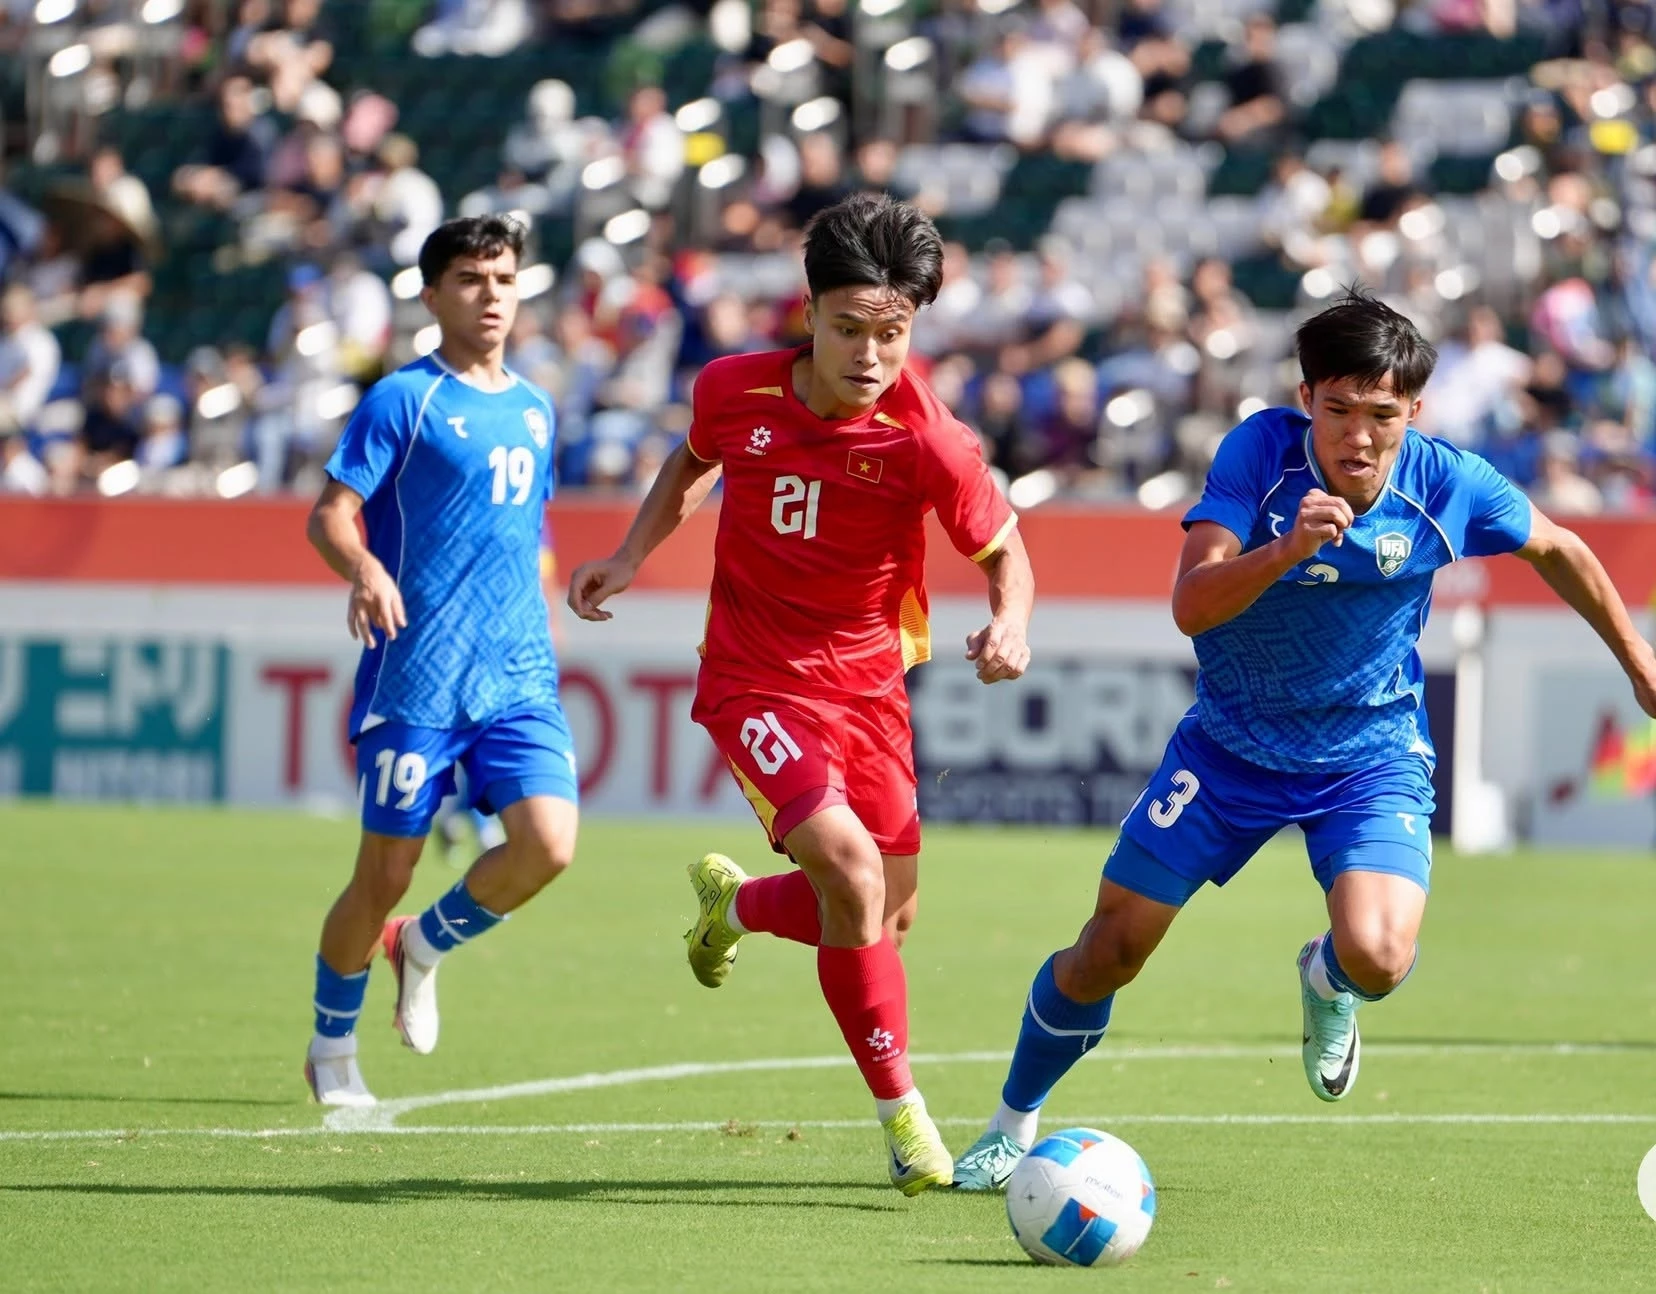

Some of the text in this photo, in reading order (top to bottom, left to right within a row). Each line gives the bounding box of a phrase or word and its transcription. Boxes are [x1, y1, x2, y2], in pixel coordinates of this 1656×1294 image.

[488, 445, 535, 506] 19
[770, 474, 822, 540] 21
[1381, 540, 1407, 558] UFA
[739, 711, 804, 775] 21
[375, 748, 427, 811] 19
[1147, 769, 1200, 829] 3
